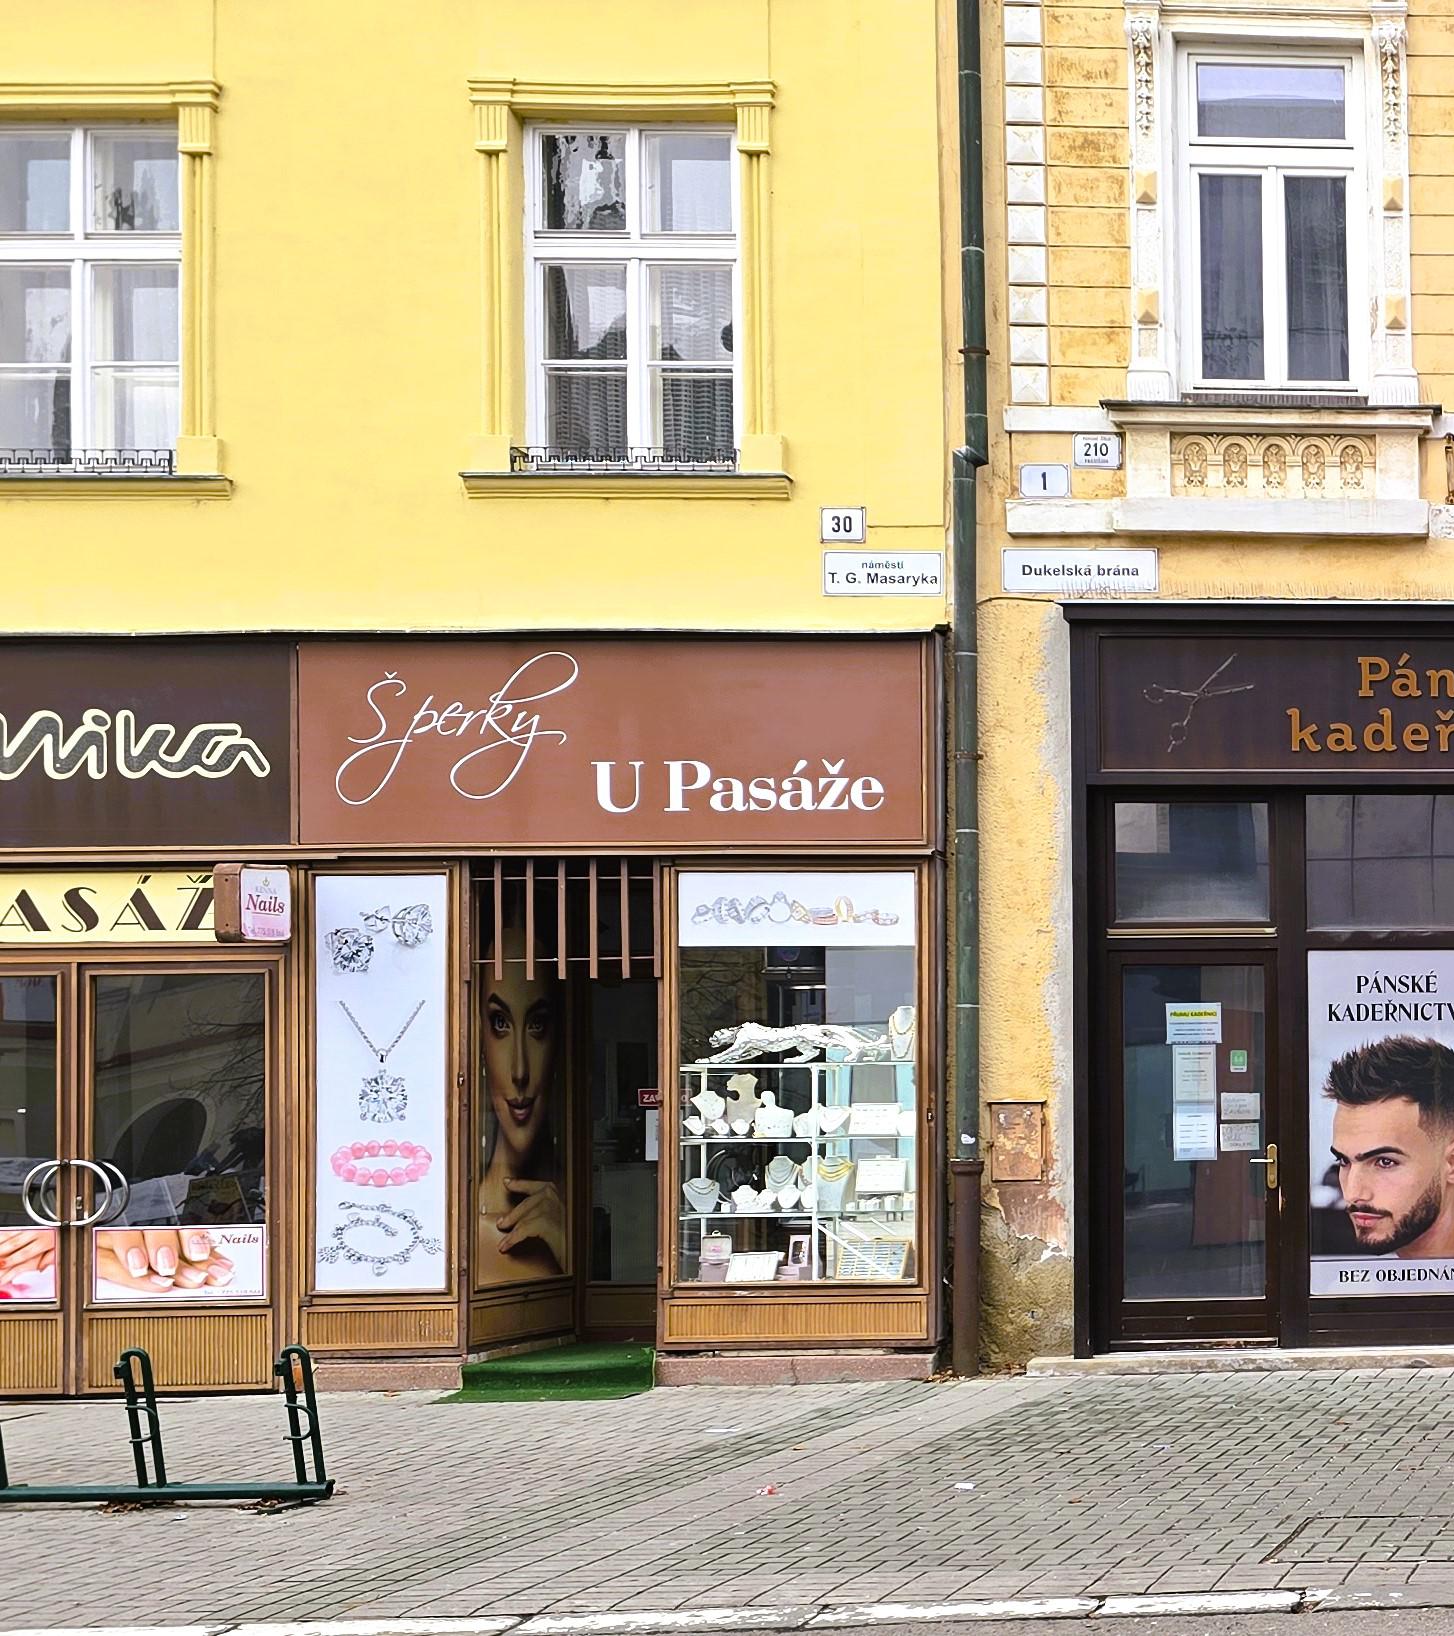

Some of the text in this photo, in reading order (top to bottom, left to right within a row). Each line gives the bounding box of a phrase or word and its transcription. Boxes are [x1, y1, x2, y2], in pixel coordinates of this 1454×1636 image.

[1083, 442, 1109, 457] 210
[1040, 471, 1048, 491] 1
[831, 515, 853, 533] 30
[861, 559, 904, 570] náměstí
[1021, 564, 1140, 577] Dukelská brána
[828, 572, 938, 588] T. G. Masaryka
[335, 650, 579, 805] Šperky
[591, 758, 886, 814] U Pasáže
[245, 893, 286, 914] Nails
[1356, 970, 1438, 994] PÁNSKÉ
[220, 1233, 259, 1244] Nails
[1339, 1269, 1371, 1283] BEZ
